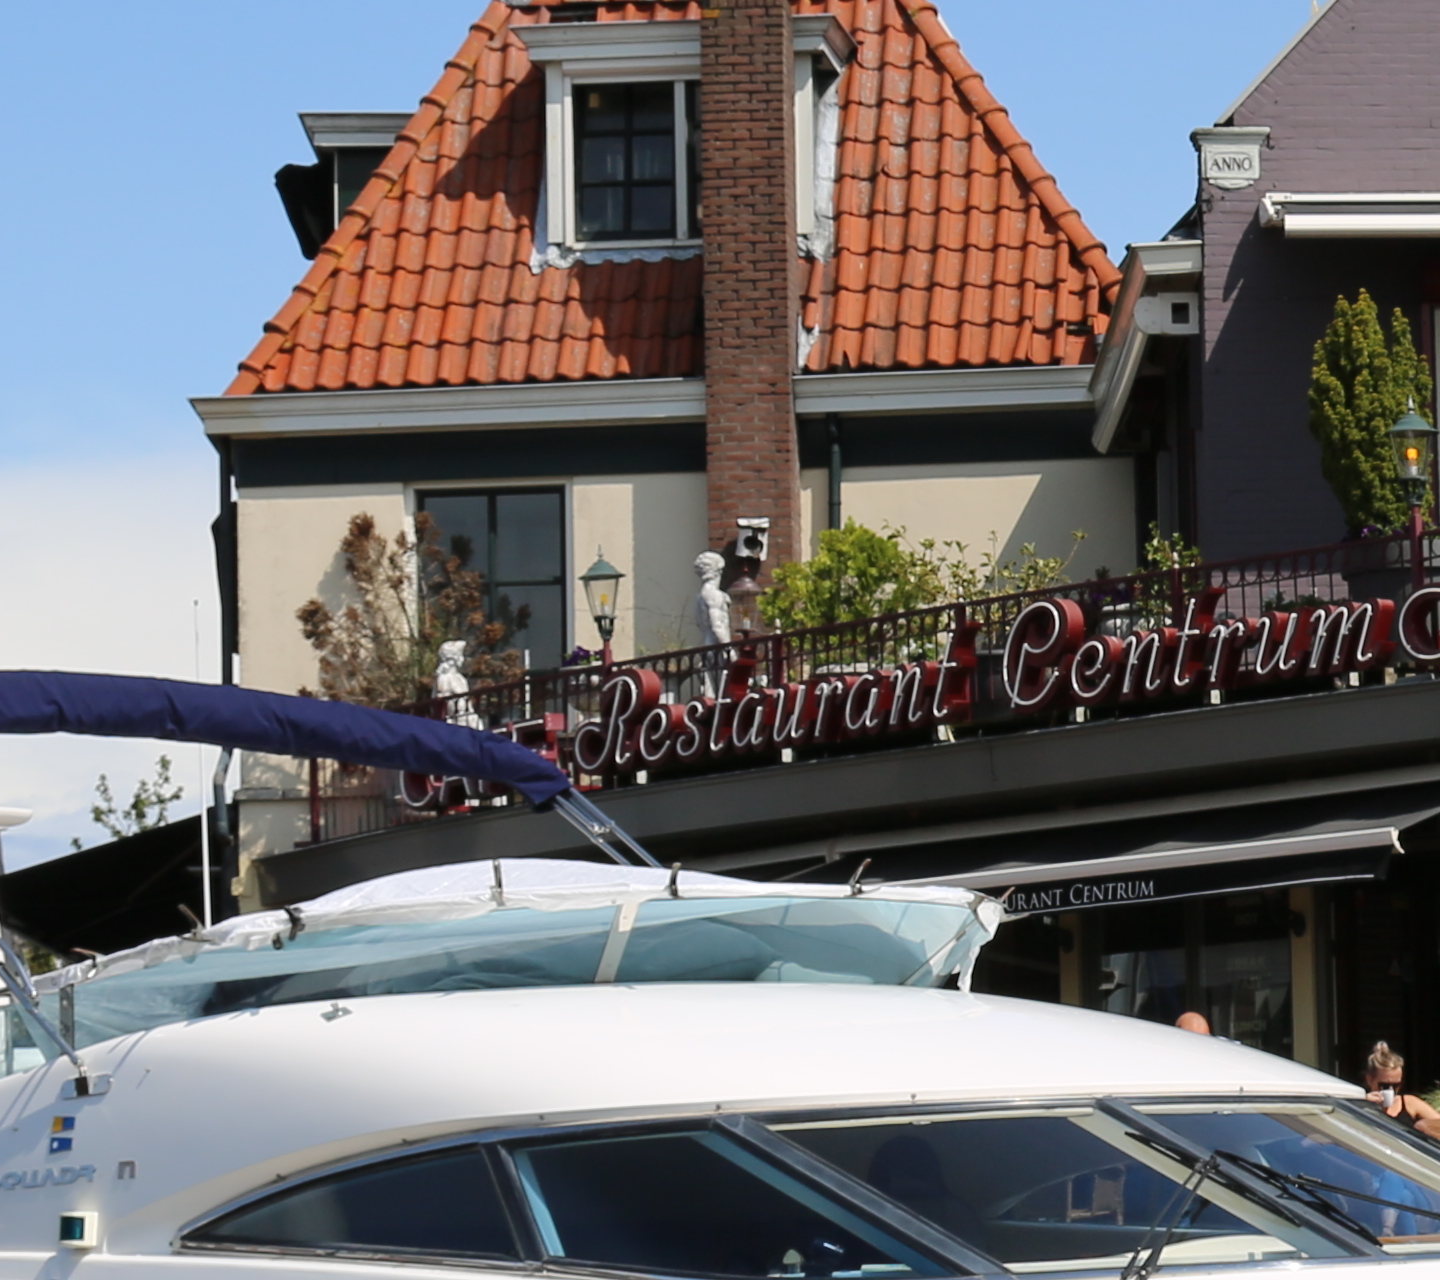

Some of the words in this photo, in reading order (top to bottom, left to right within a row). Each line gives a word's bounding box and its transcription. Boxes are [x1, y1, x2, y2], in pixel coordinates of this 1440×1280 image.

[1210, 157, 1252, 171] ANNO
[574, 604, 982, 778] Restaurant
[1003, 587, 1396, 710] Centrum
[1069, 880, 1155, 904] CENTRUM
